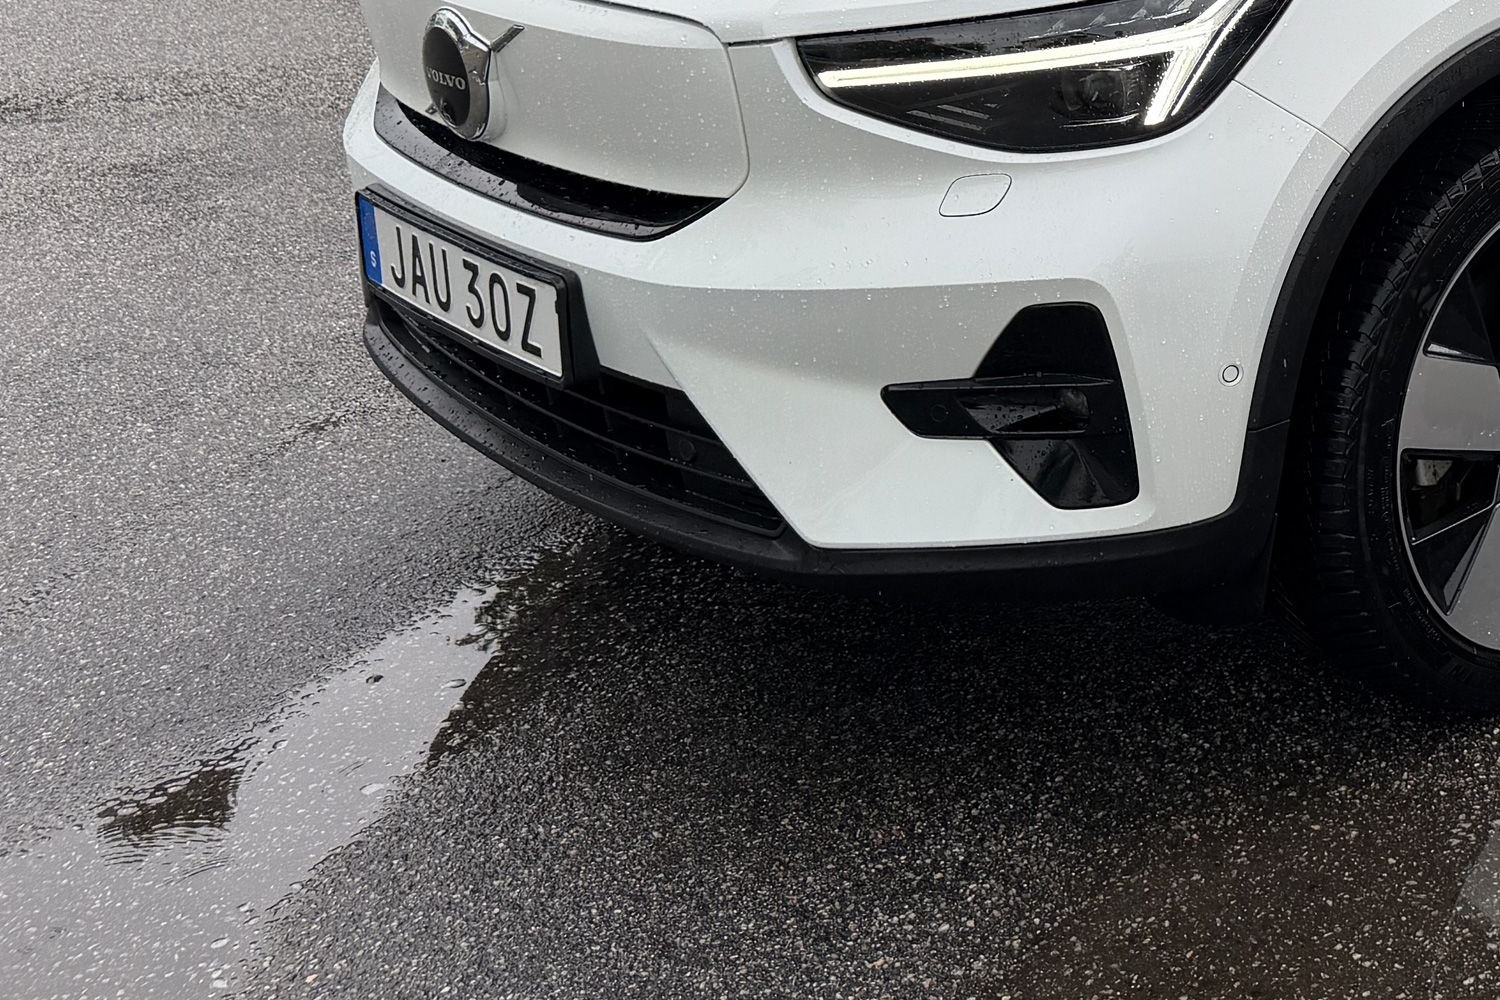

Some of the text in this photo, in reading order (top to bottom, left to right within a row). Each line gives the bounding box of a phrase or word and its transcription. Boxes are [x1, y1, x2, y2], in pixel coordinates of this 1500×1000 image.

[426, 65, 467, 91] VOLVO
[369, 250, 377, 268] S
[390, 225, 543, 359] JAU 30Z
